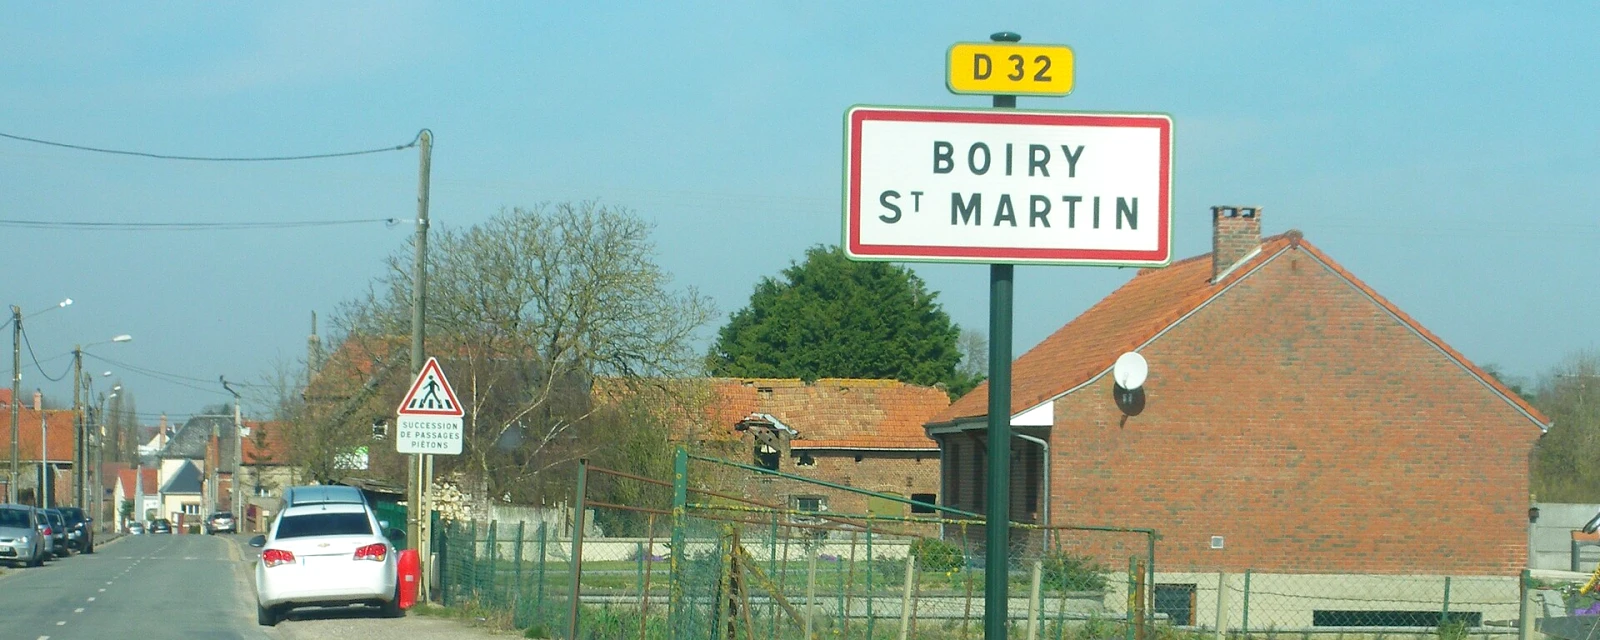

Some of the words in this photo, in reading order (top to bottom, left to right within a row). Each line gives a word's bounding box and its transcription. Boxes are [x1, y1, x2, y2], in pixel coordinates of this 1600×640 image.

[973, 53, 992, 80] D
[1007, 54, 1052, 82] 32
[933, 140, 1085, 178] BOIRY
[950, 192, 1138, 230] MARTIN
[402, 421, 458, 430] SUCCESSION
[411, 441, 448, 449] PIÉTONS
[415, 432, 460, 440] PASSAGES
